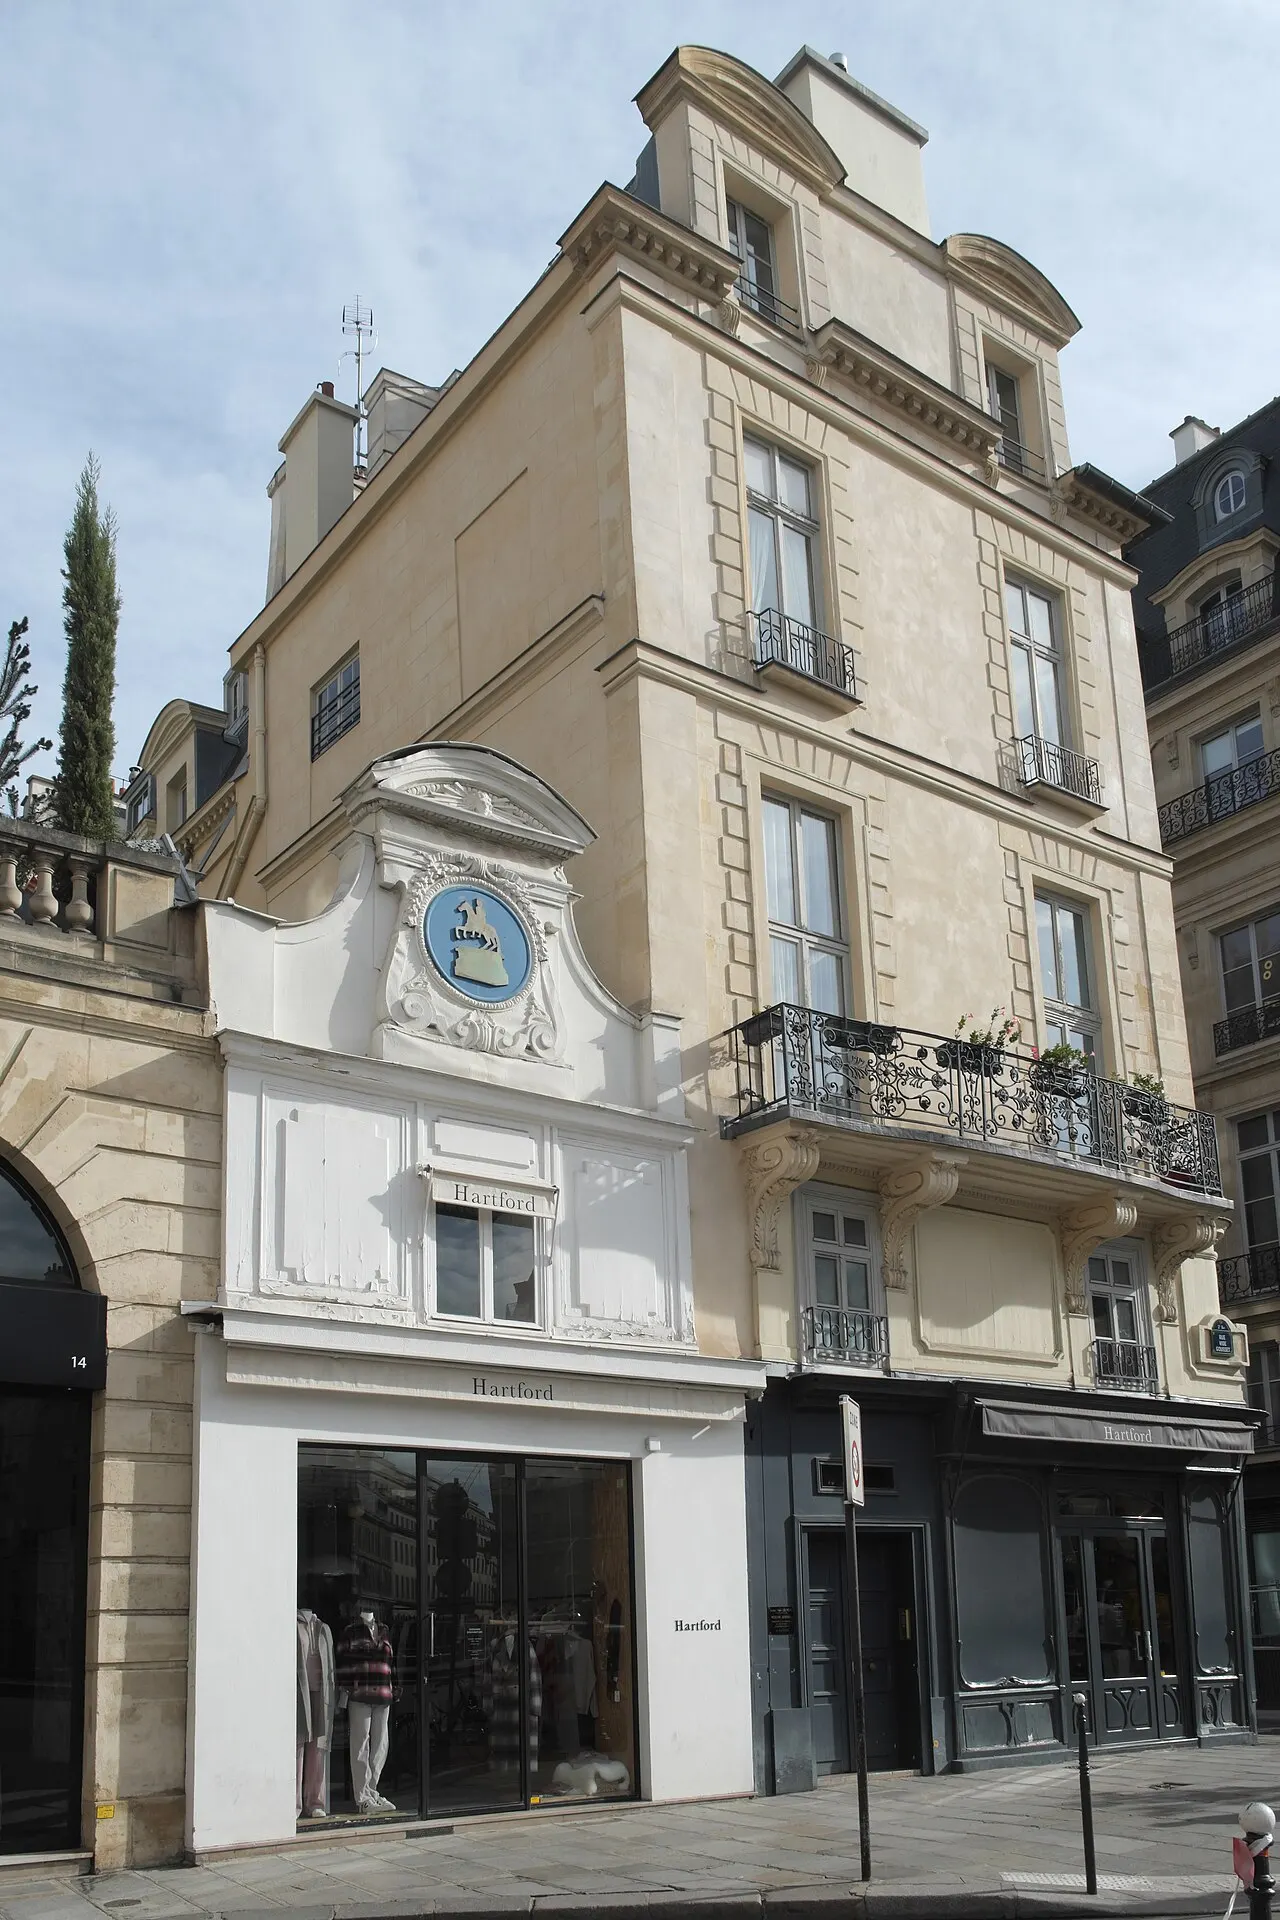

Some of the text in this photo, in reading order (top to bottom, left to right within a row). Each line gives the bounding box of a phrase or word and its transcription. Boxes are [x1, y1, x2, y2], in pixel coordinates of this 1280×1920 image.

[454, 1183, 536, 1212] Hartford
[71, 1356, 87, 1369] 14
[472, 1377, 553, 1401] Hartford
[1103, 1425, 1152, 1443] Hartford
[674, 1619, 721, 1632] Hartford
